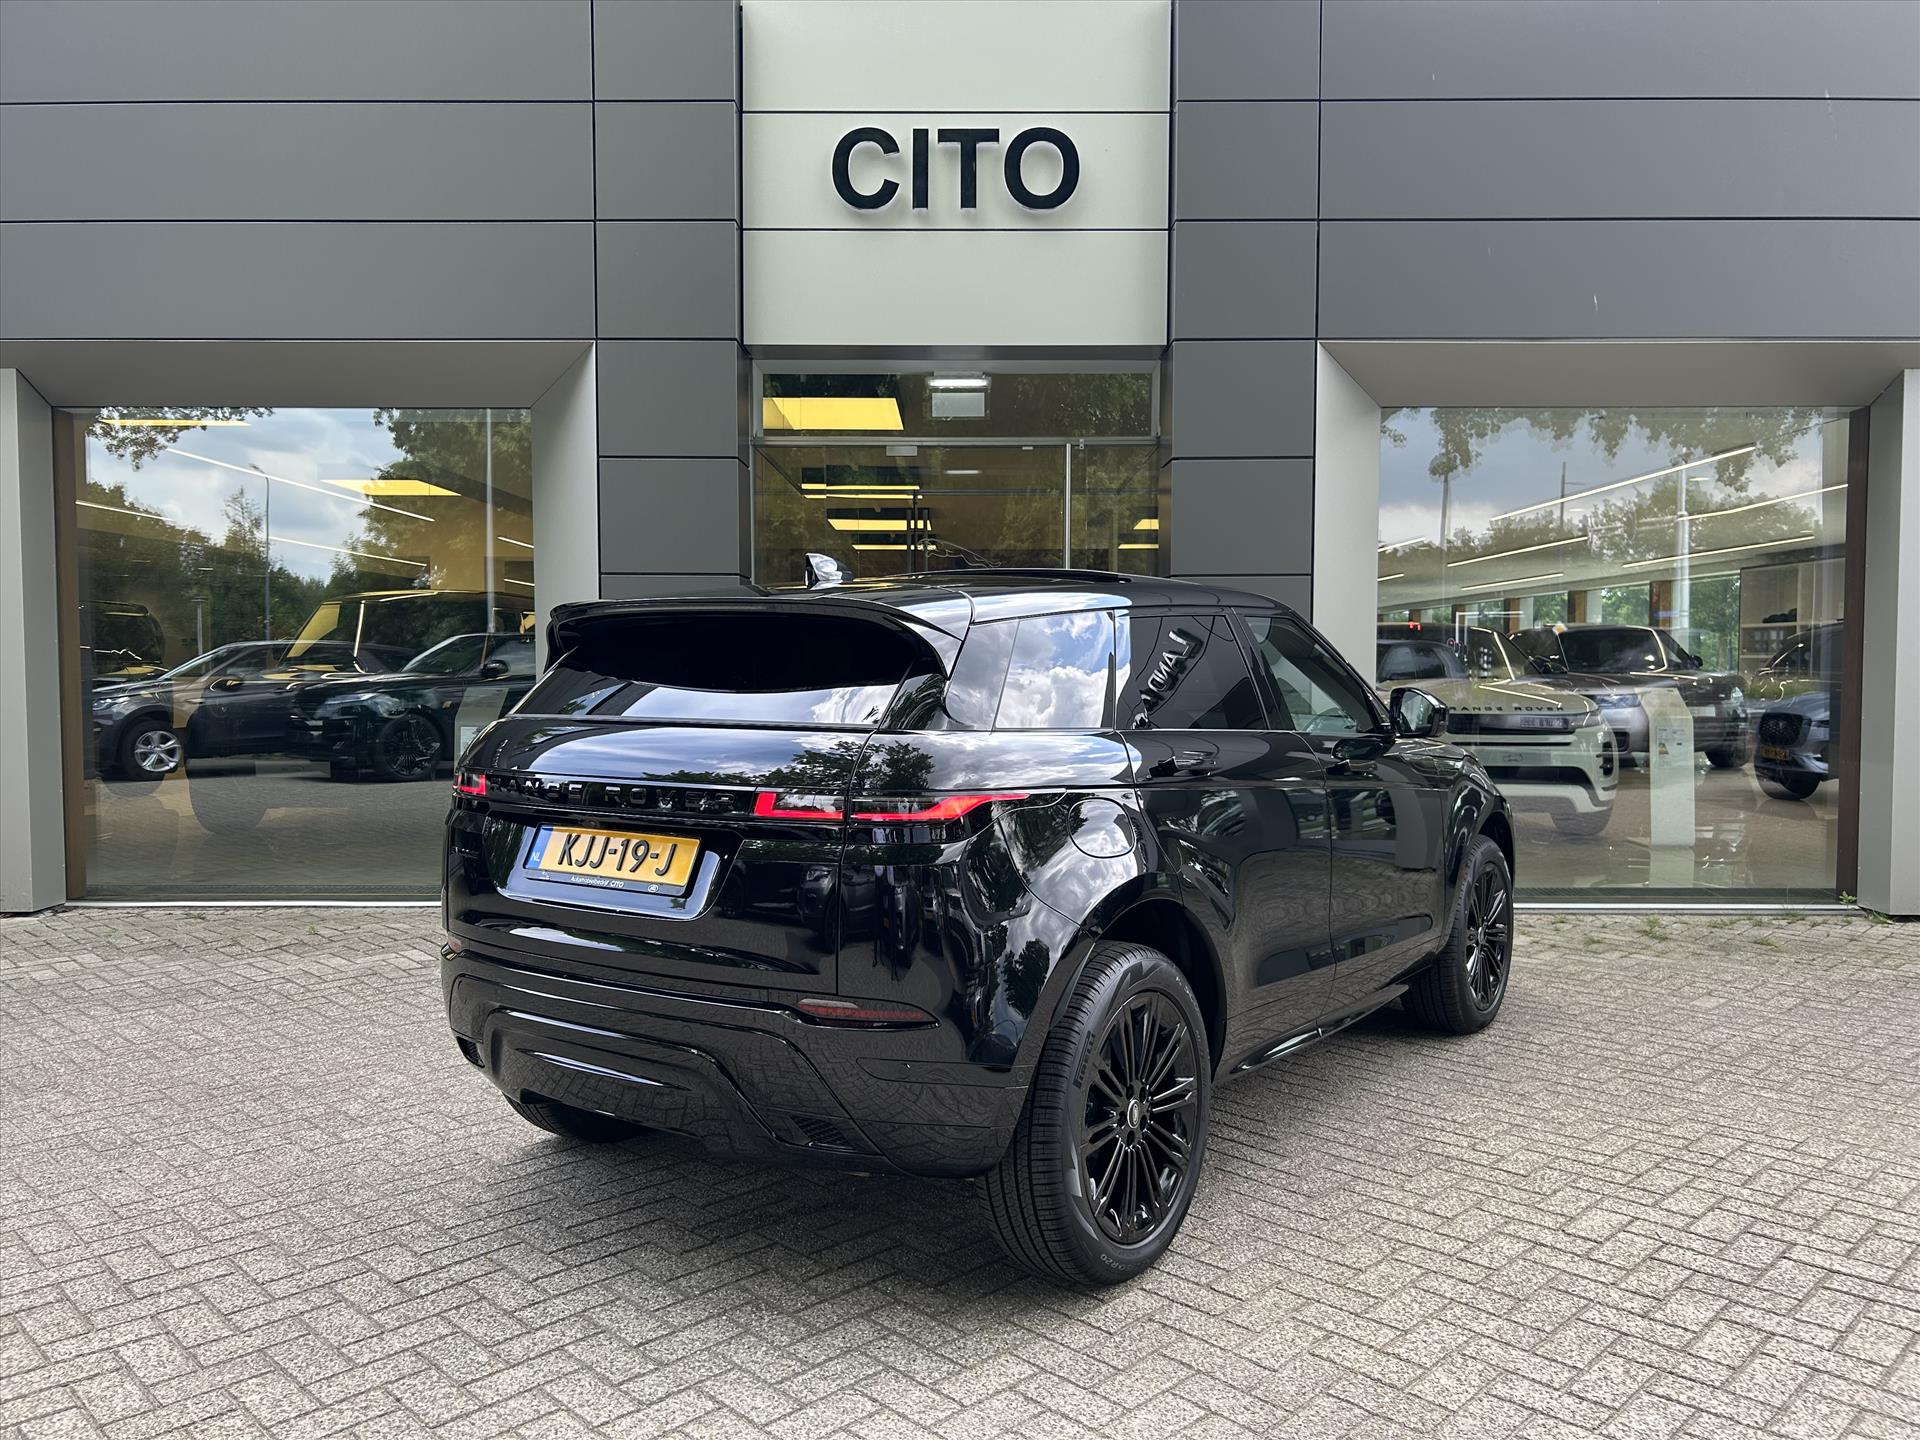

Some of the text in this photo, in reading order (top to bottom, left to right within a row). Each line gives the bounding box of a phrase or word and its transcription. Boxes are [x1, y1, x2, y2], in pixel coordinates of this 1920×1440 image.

[831, 126, 1080, 210] CITO
[605, 785, 737, 811] ROVER
[530, 851, 540, 862] NL
[557, 833, 678, 876] KJJ-19-J
[610, 880, 625, 888] CITO
